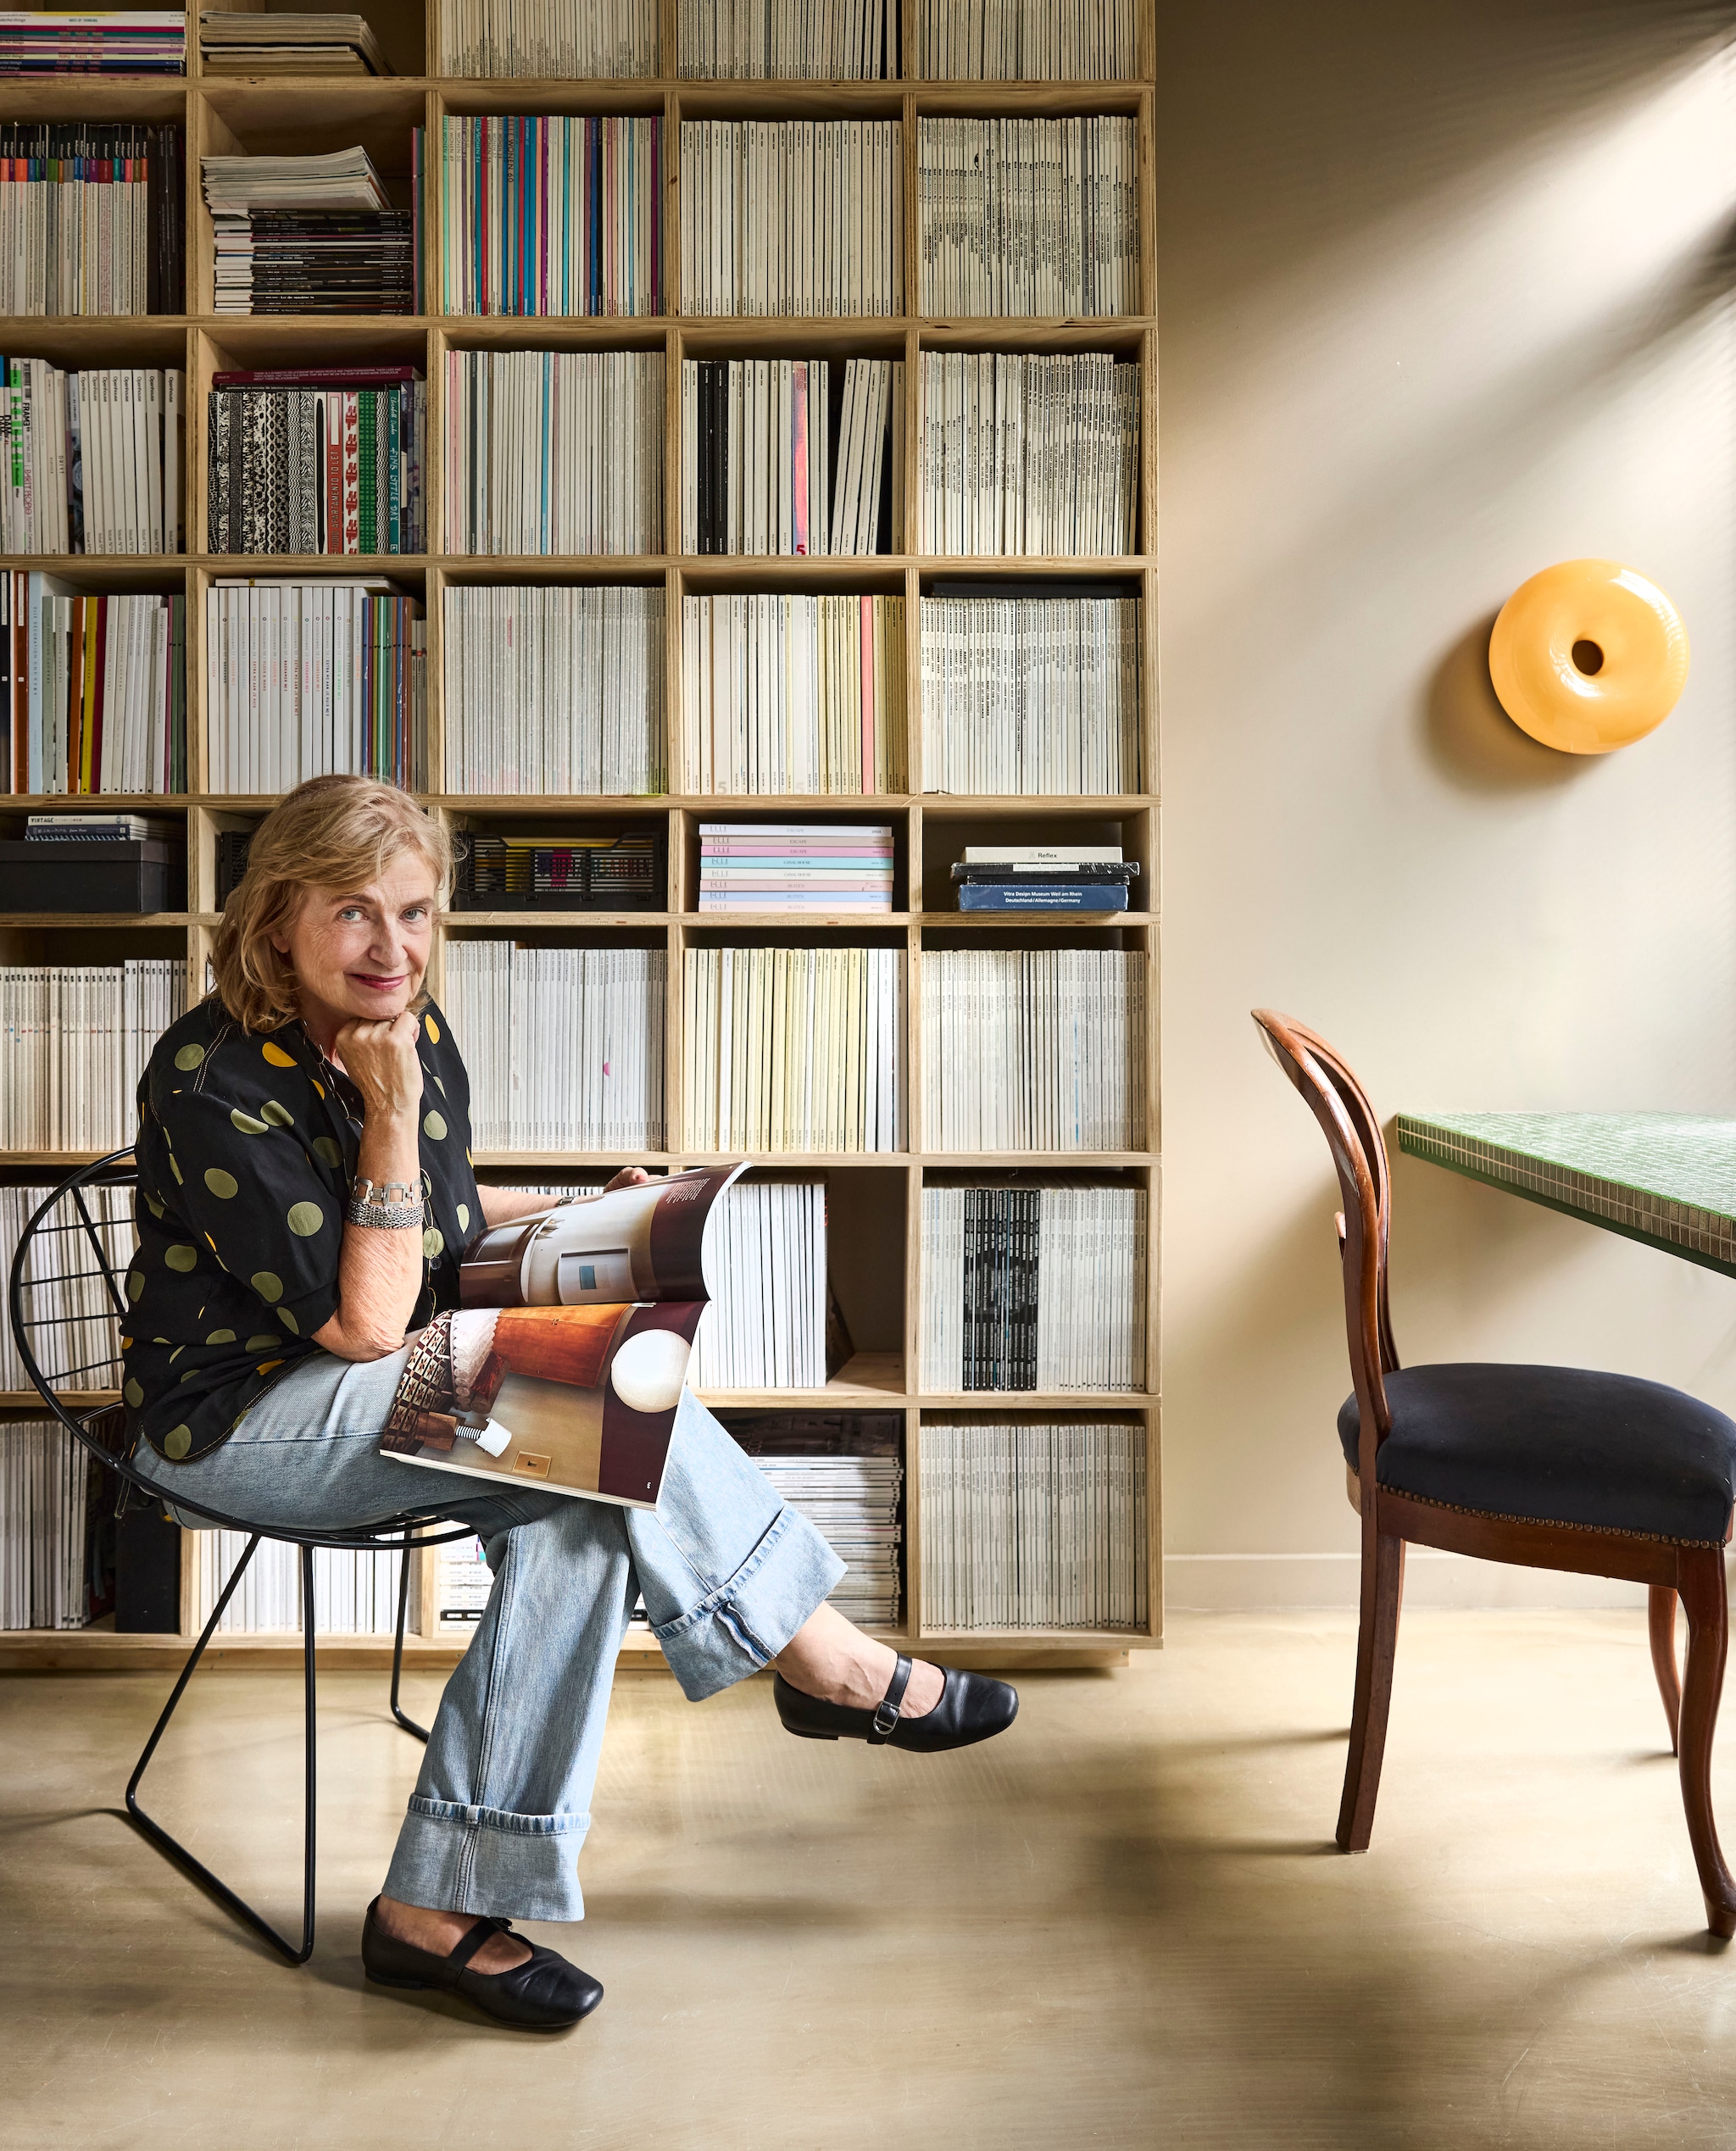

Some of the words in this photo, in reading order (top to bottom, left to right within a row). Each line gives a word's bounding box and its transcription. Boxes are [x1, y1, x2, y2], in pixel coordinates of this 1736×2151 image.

[507, 172, 514, 183] 60
[390, 447, 398, 470] FINE
[796, 545, 806, 555] 5
